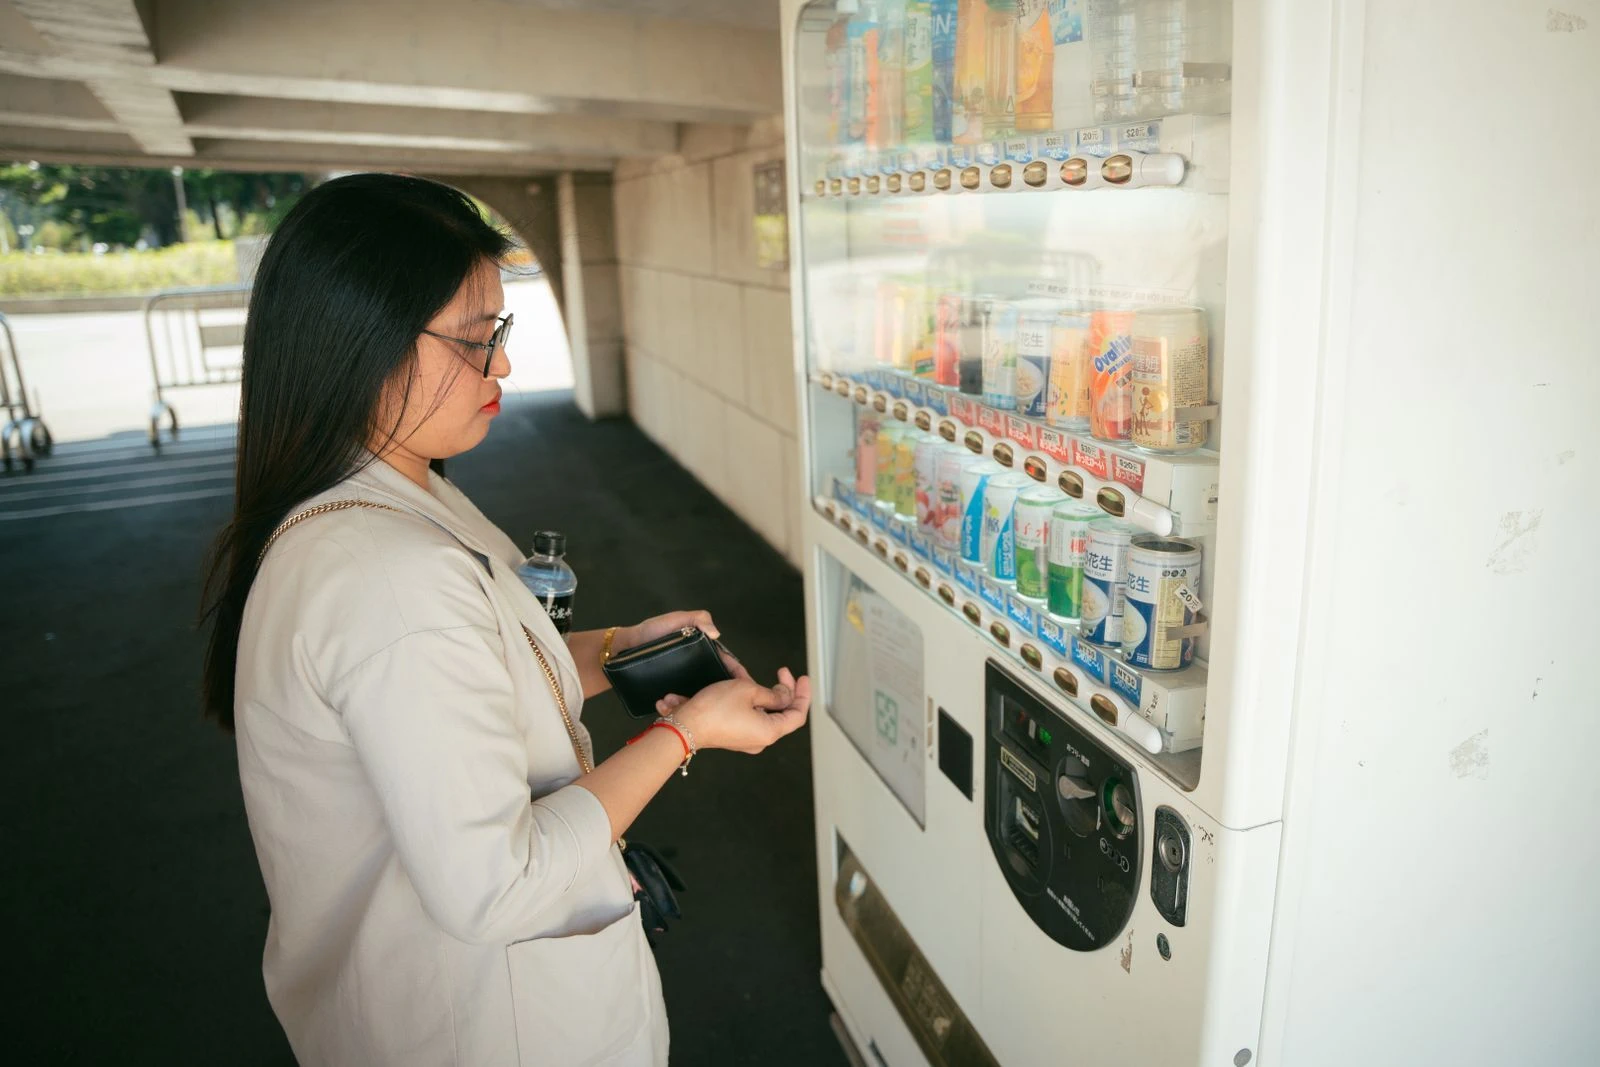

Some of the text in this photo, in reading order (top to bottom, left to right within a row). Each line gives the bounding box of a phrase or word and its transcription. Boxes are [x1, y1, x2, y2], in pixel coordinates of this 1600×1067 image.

[1082, 131, 1099, 141] 20元
[1179, 588, 1200, 609] 20元
[1077, 642, 1096, 660] NT30
[1117, 667, 1137, 688] NT30
